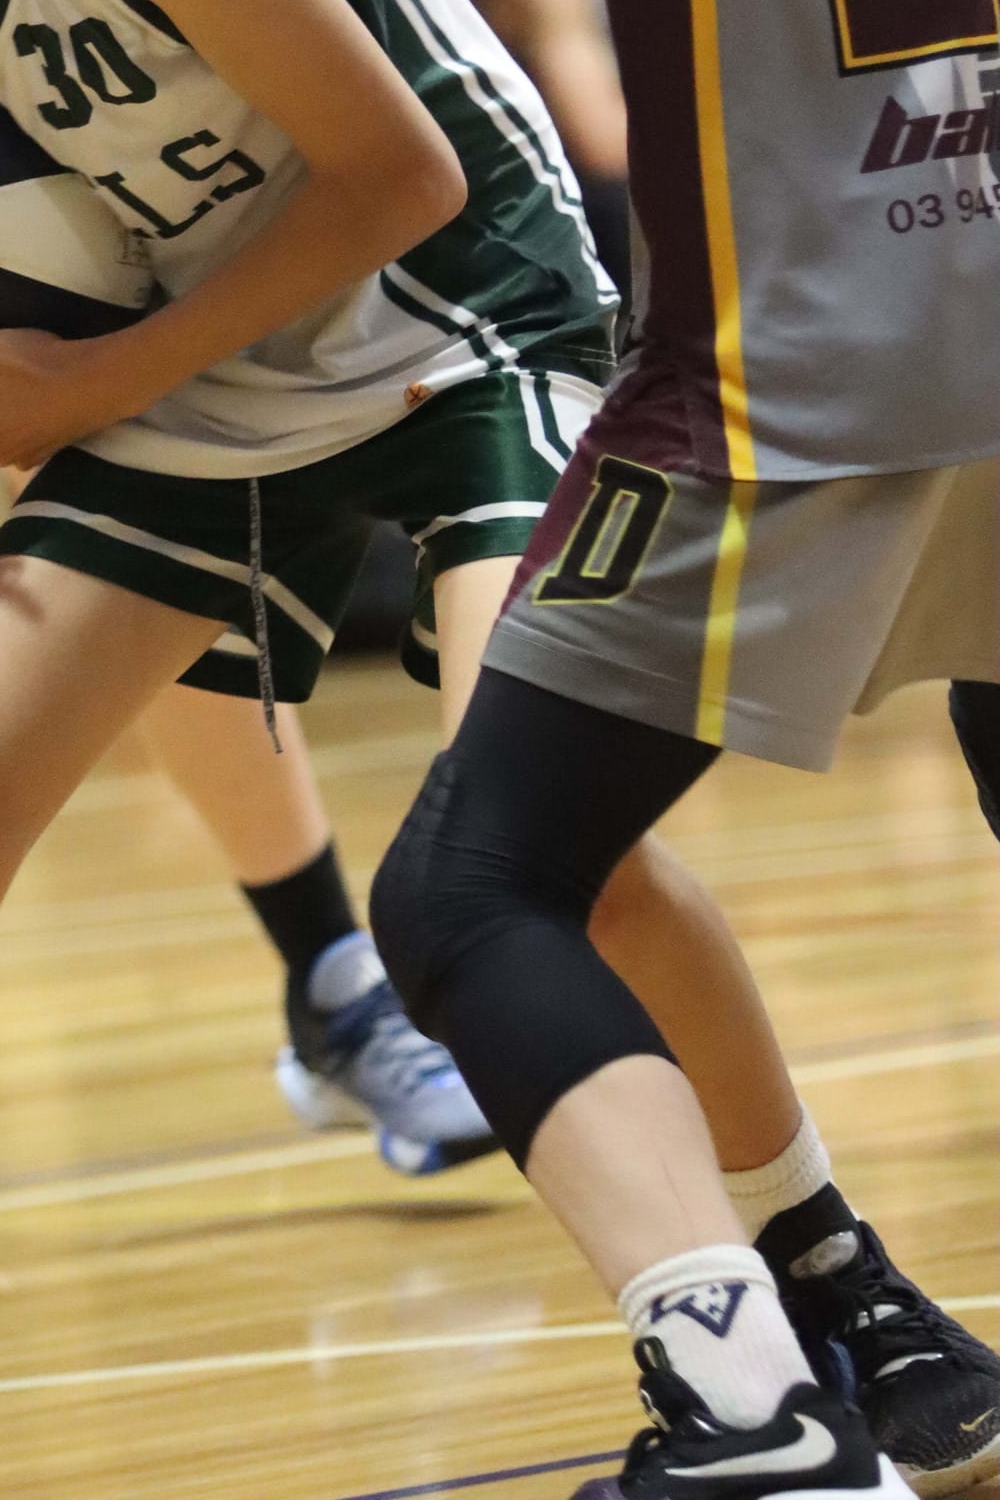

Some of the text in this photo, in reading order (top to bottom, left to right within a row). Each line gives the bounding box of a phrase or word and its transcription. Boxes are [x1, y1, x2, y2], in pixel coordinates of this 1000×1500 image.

[13, 17, 157, 130] 30
[887, 194, 945, 234] 03
[532, 454, 674, 605] D
